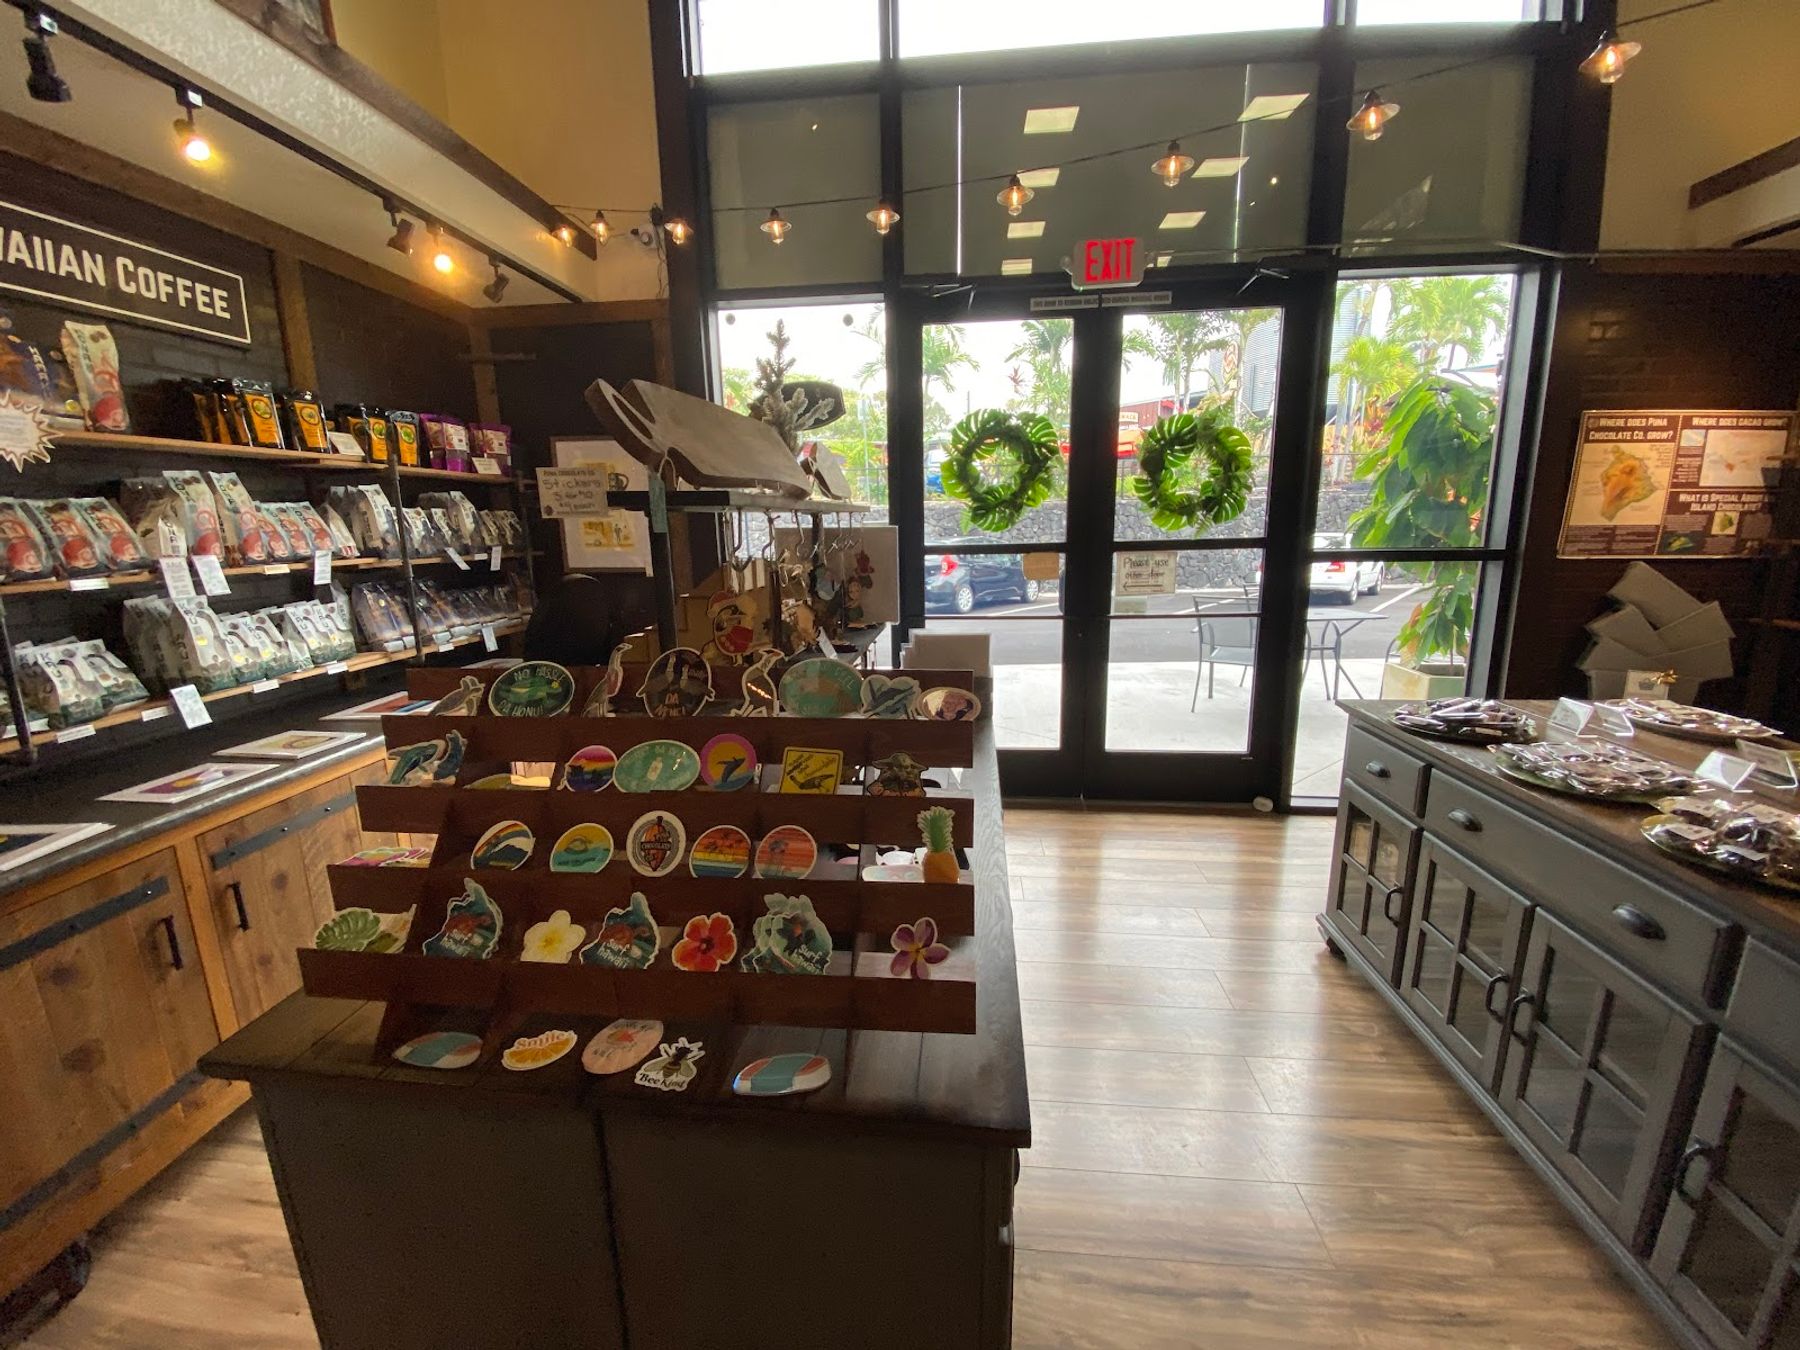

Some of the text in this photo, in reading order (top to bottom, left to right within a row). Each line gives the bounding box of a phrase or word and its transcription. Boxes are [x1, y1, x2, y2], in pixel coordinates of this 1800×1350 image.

[1086, 238, 1135, 282] EXIT
[0, 227, 231, 319] AIIAN COFFEE
[1599, 417, 1667, 427] WHERE DOES PUNA
[1692, 417, 1718, 426] WHERE
[1718, 418, 1737, 426] DOES
[1589, 430, 1674, 440] CHOCOLATE CO. GROW?
[1679, 494, 1700, 502] WHAT
[1701, 494, 1709, 502] IS
[1710, 493, 1739, 502] SPECIAL
[514, 669, 531, 681] NO
[664, 692, 680, 705] DA
[799, 943, 823, 963] Surf
[516, 1032, 565, 1049] Smile
[640, 1073, 687, 1088] Bee Kind
